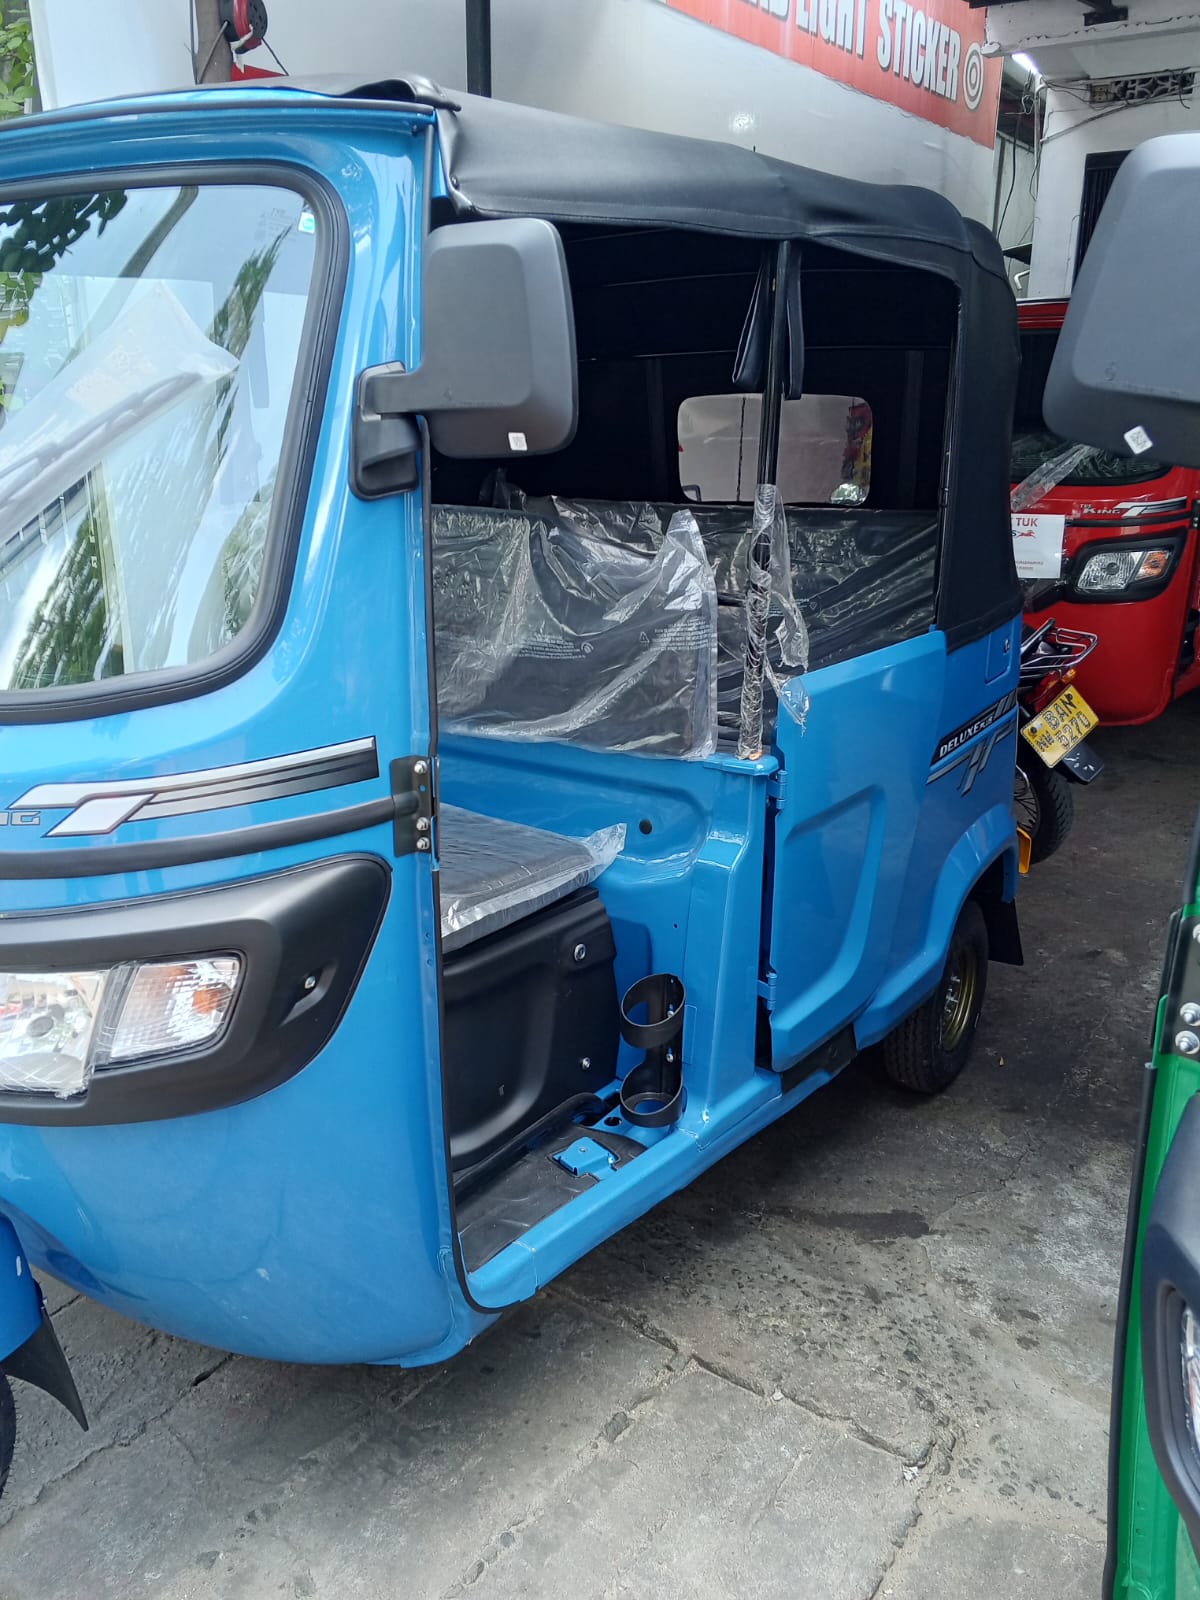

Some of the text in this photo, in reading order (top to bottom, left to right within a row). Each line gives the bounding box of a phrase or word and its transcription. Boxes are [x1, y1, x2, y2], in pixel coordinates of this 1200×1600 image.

[877, 0, 961, 102] STICKER
[1016, 518, 1038, 527] TUK
[939, 721, 981, 758] DELUXE
[1054, 711, 1091, 749] 5270
